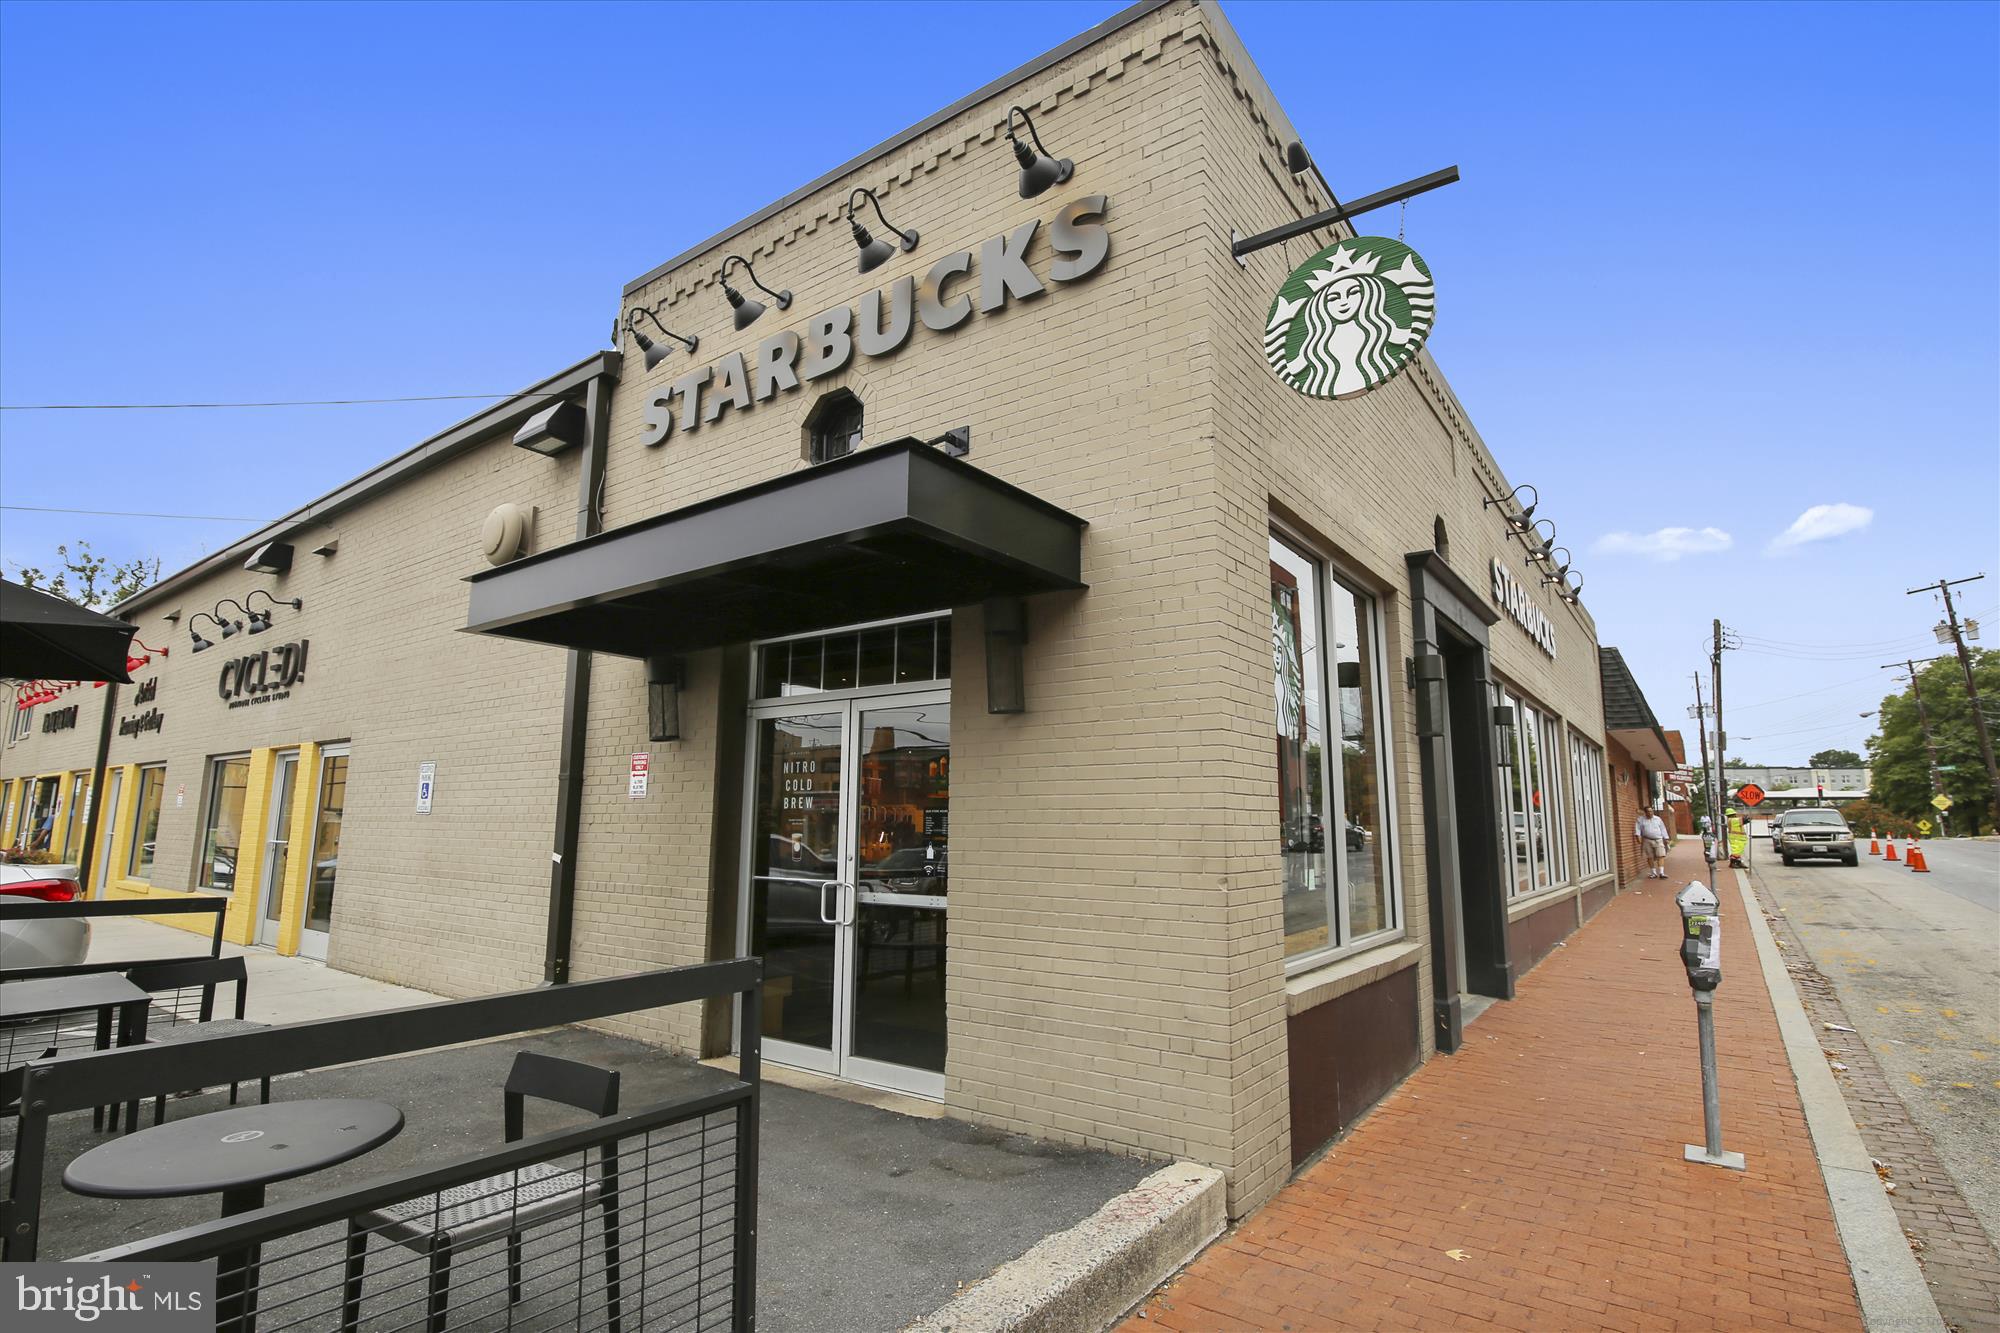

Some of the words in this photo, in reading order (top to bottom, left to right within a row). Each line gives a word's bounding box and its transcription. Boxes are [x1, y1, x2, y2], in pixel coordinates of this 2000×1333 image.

[640, 194, 1110, 447] STARBUCKS
[1491, 556, 1557, 660] STARBUCKS
[219, 639, 310, 700] CYCLED!
[783, 760, 816, 774] NITRO
[785, 778, 813, 792] COLD
[1741, 791, 1761, 800] SLOW
[783, 796, 814, 810] BREW
